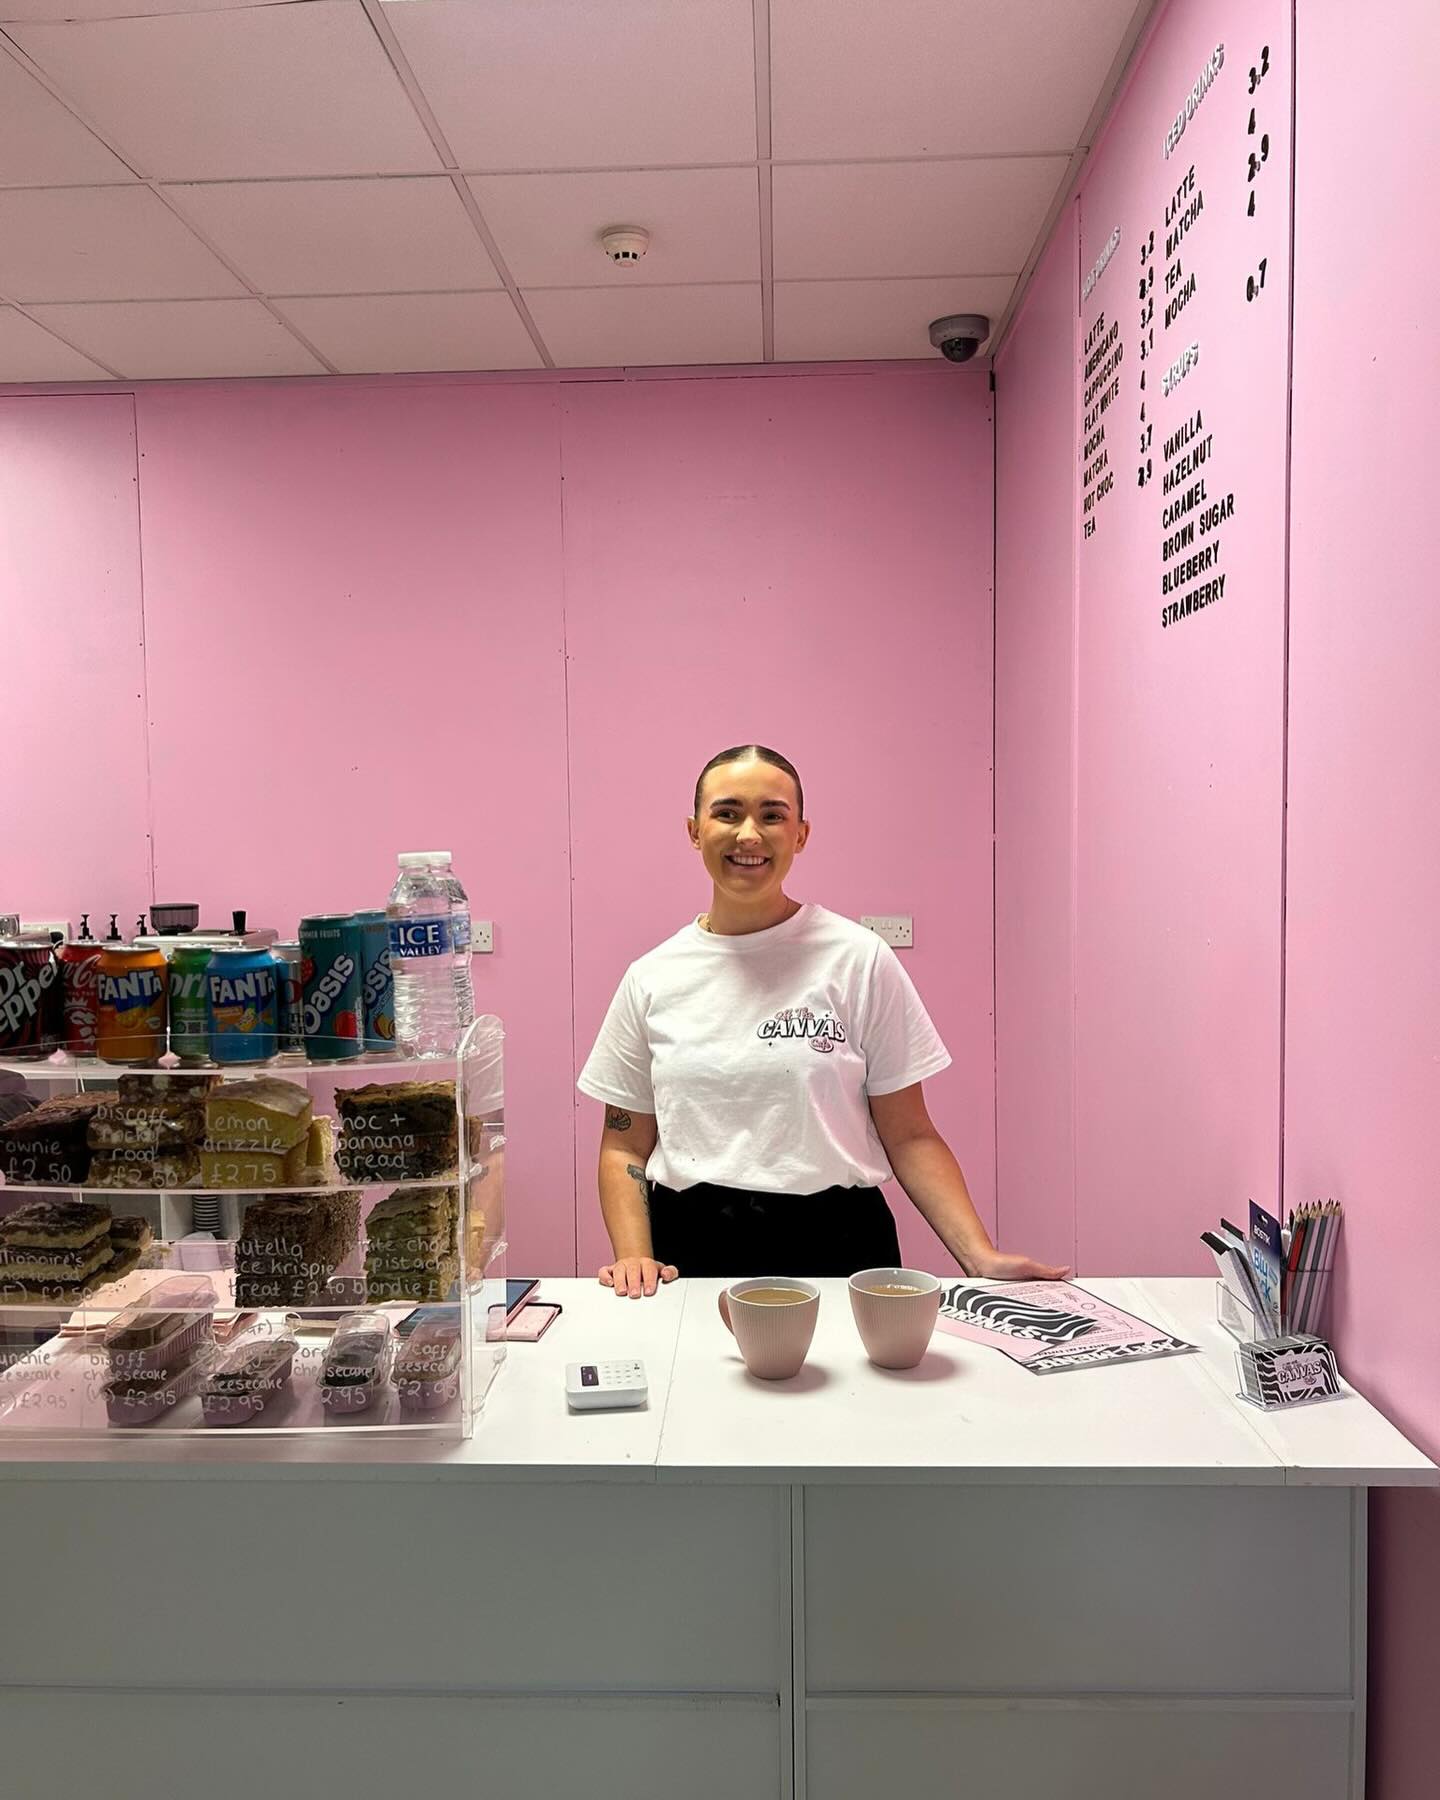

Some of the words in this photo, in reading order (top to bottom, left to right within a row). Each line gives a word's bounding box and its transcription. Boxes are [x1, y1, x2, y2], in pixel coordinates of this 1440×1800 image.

[1186, 43, 1224, 120] DRINKS
[1165, 165, 1195, 227] LATTE
[1166, 191, 1203, 260] MATCHA
[1165, 258, 1182, 294] TEA
[1165, 273, 1196, 329] MOCHA
[1084, 312, 1104, 355] LATTE
[1084, 321, 1118, 382] AMERICANO
[1084, 343, 1123, 407] CAPPUCCINO
[1084, 406, 1100, 434] FLAT
[1100, 377, 1119, 416] WHITE
[1084, 425, 1105, 461] MOCHA
[1163, 409, 1203, 462] VANILLA
[1083, 449, 1108, 488] MATCHA
[1163, 434, 1213, 496] HAZELNUT
[1083, 490, 1096, 514] HOT
[1096, 472, 1114, 502] CHOC
[1163, 479, 1207, 530] CARAMEL
[1083, 516, 1096, 540] TEA
[1163, 520, 1194, 562] BROWN
[1199, 493, 1234, 536] SUGAR
[1162, 540, 1219, 595] BLUEBERRY
[1162, 574, 1226, 628] STRAWBERRY
[399, 924, 440, 946] ICE
[399, 945, 442, 957] VALLEY
[0, 950, 57, 1032] epper
[97, 970, 164, 1001] FANTA
[210, 971, 276, 1004] FANTA
[363, 947, 392, 1005] asis
[757, 1017, 846, 1043] CANVAS
[329, 1113, 382, 1132] choc
[390, 1113, 406, 1128] +
[0, 1139, 63, 1155] ownie
[203, 1136, 286, 1152] drizzle
[337, 1151, 409, 1169] bread
[234, 1237, 303, 1259] nutella
[372, 1253, 459, 1274] pistachio
[271, 1258, 335, 1279] krispie
[228, 1278, 280, 1297] treat
[352, 1279, 422, 1296] blondie
[938, 1305, 1042, 1340] DRINKS
[0, 1350, 51, 1367] unchie
[90, 1350, 147, 1366] bisoff
[1277, 1360, 1323, 1384] CANVAS
[123, 1387, 177, 1406] £2.95
[197, 1377, 283, 1392] cheesecake
